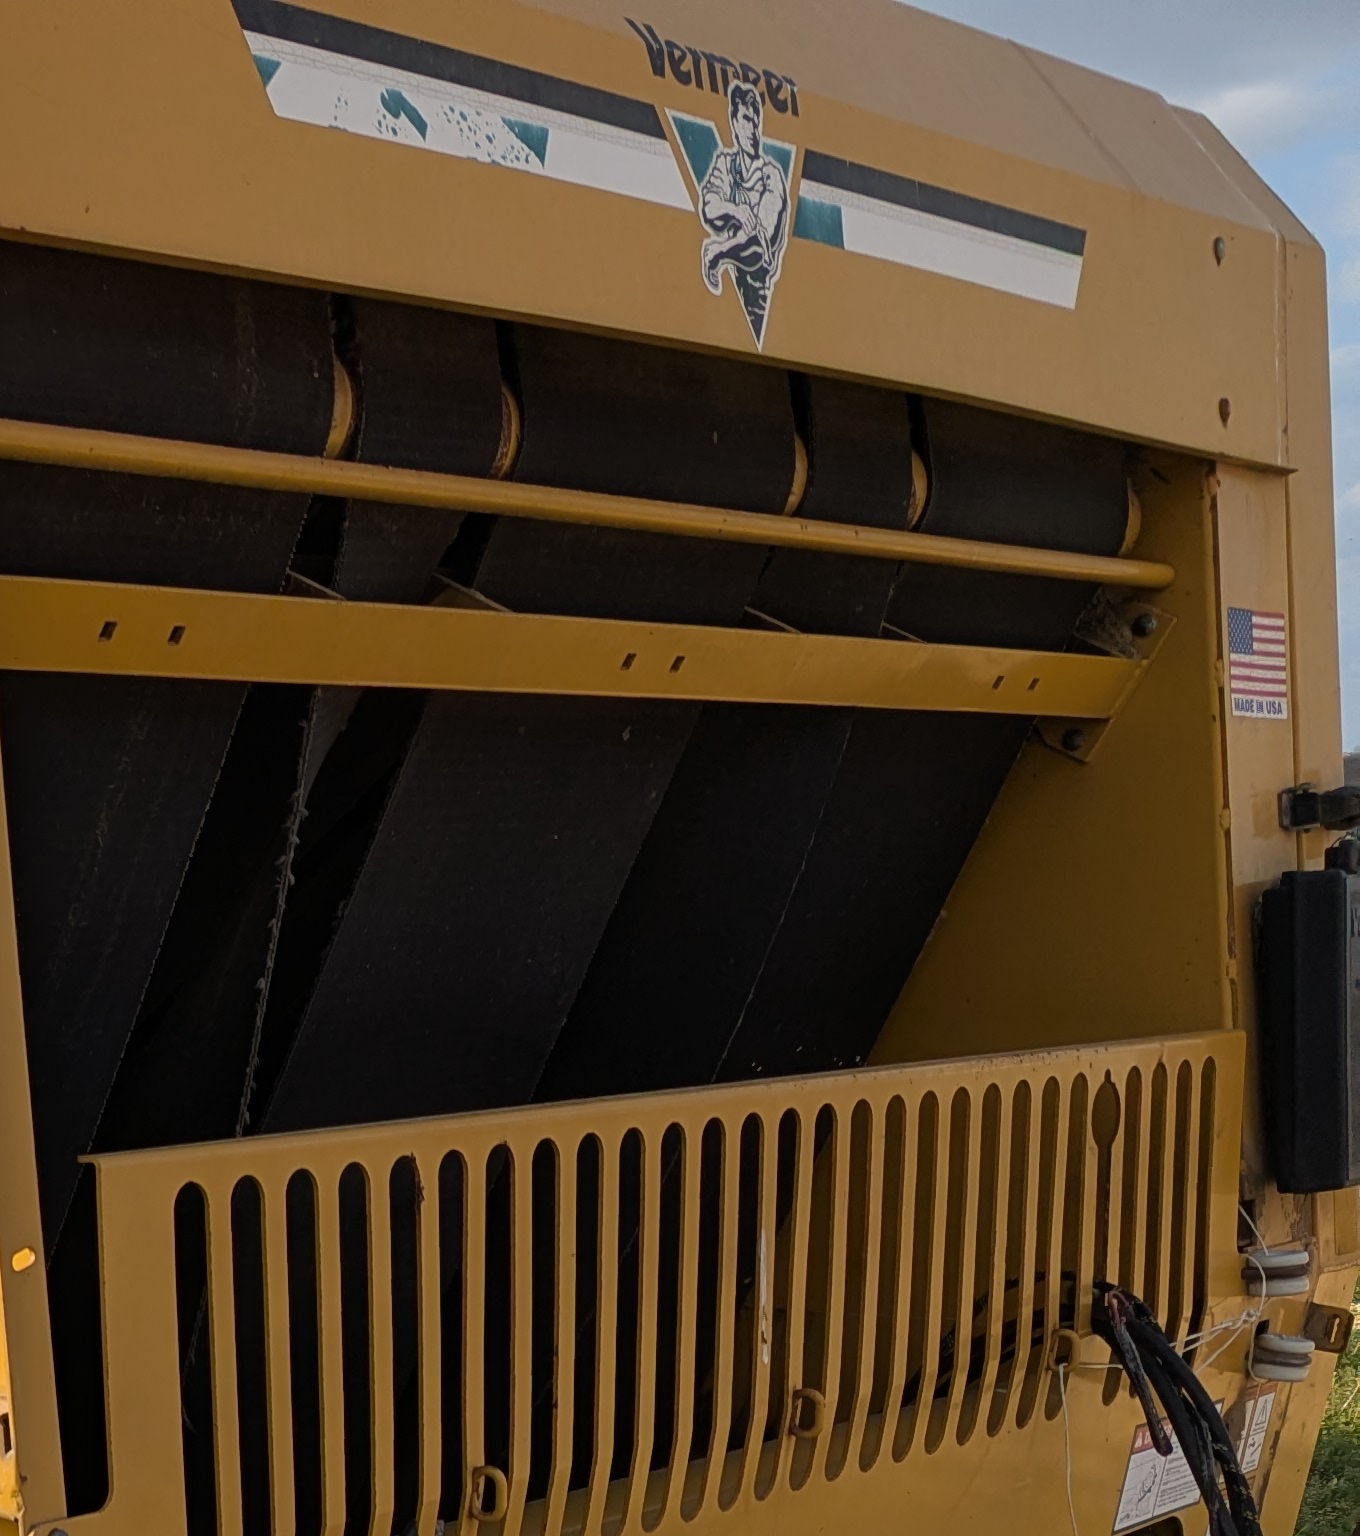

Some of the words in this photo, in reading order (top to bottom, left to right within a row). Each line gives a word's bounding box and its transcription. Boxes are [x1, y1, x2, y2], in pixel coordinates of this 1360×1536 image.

[625, 17, 799, 118] Vermeer
[1234, 697, 1255, 713] MADE
[1257, 701, 1264, 714] IN
[1266, 701, 1283, 715] USA
